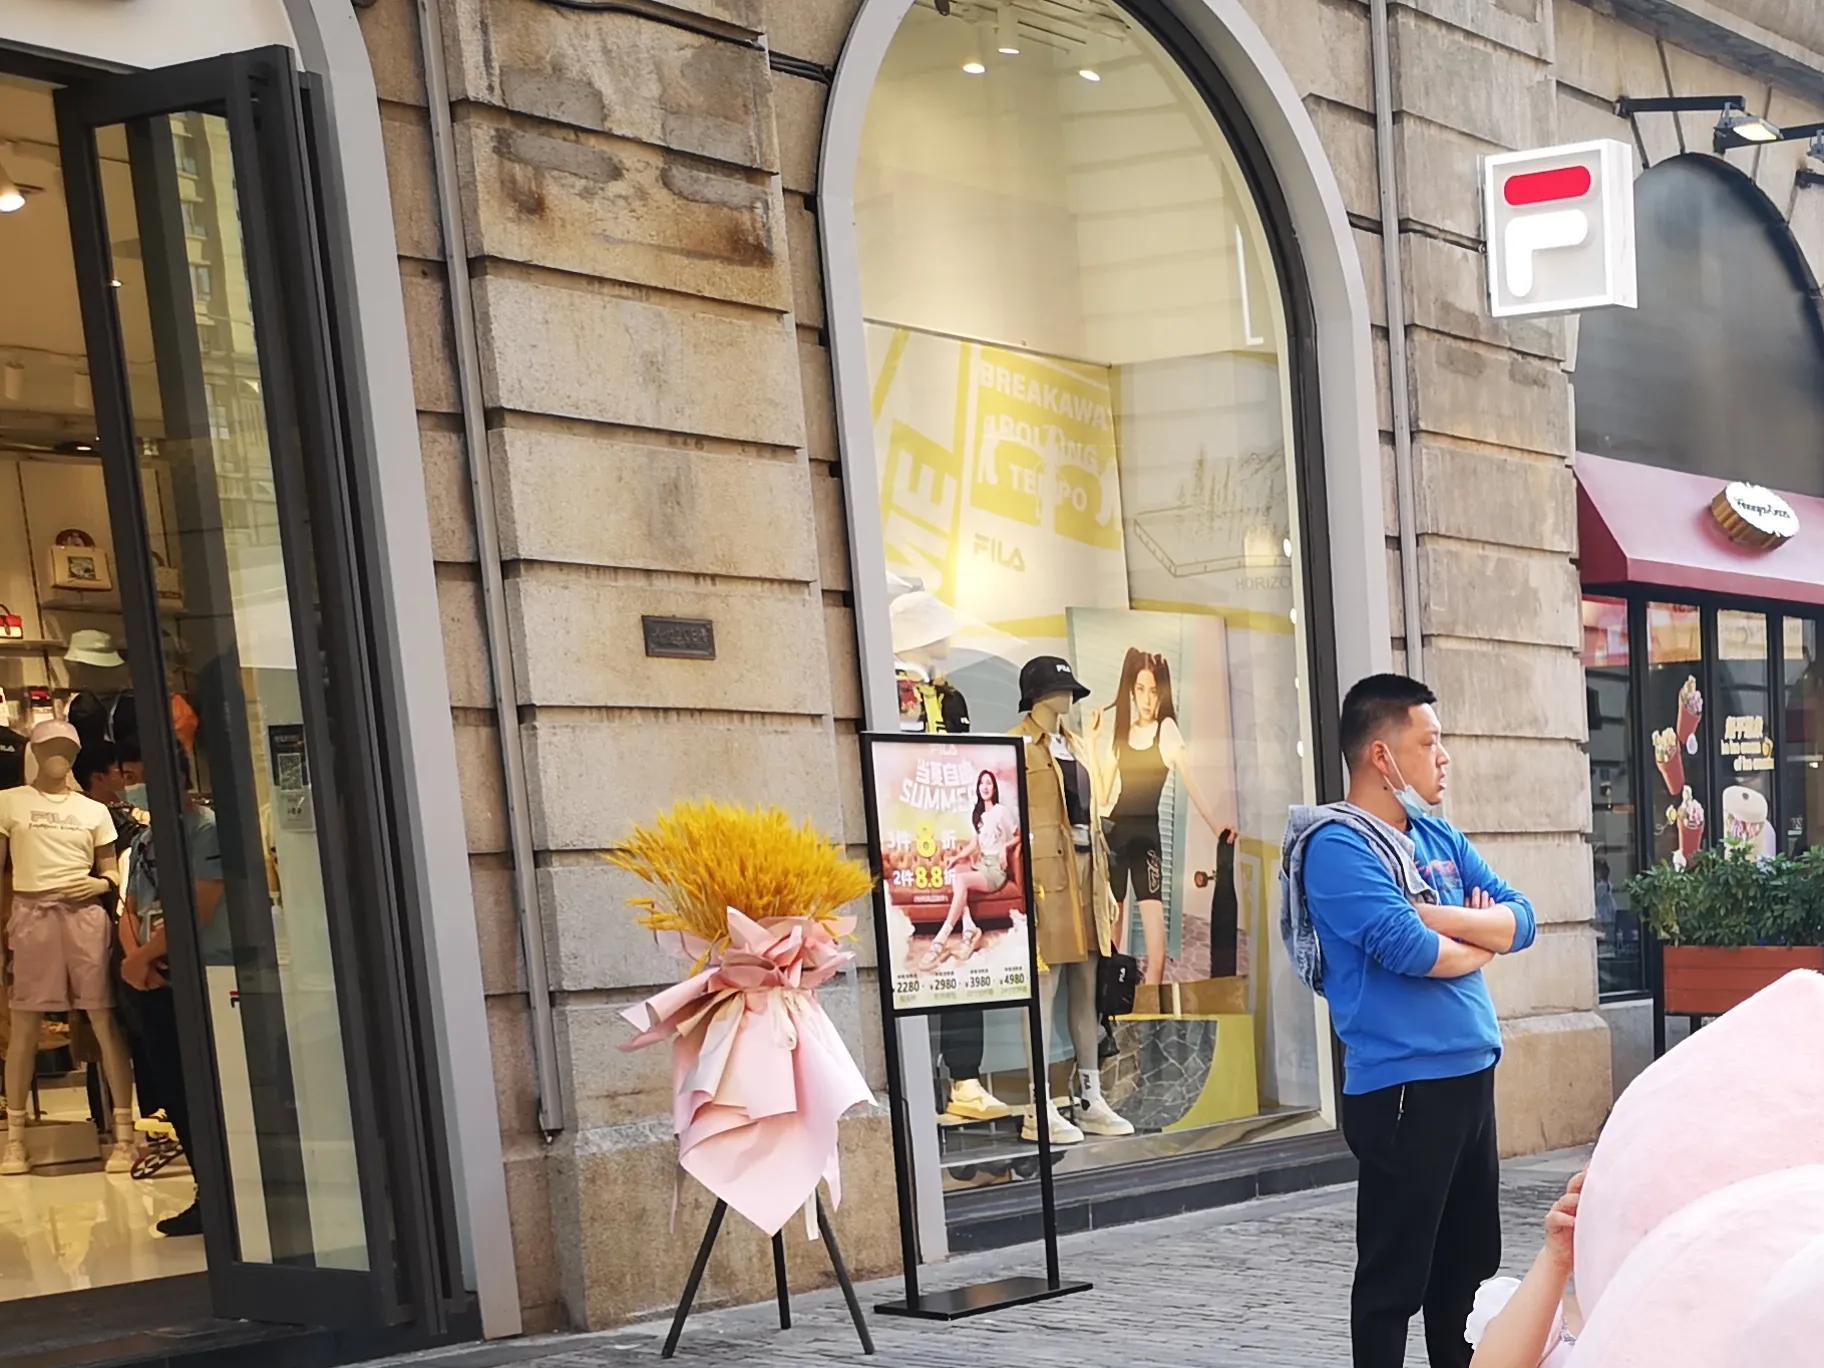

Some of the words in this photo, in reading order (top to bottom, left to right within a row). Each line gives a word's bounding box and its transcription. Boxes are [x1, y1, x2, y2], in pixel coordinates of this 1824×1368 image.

[979, 360, 1111, 431] BREAKAWA
[1009, 463, 1088, 512] TEPO
[973, 532, 1026, 573] FILA
[1235, 575, 1292, 591] HORIZO
